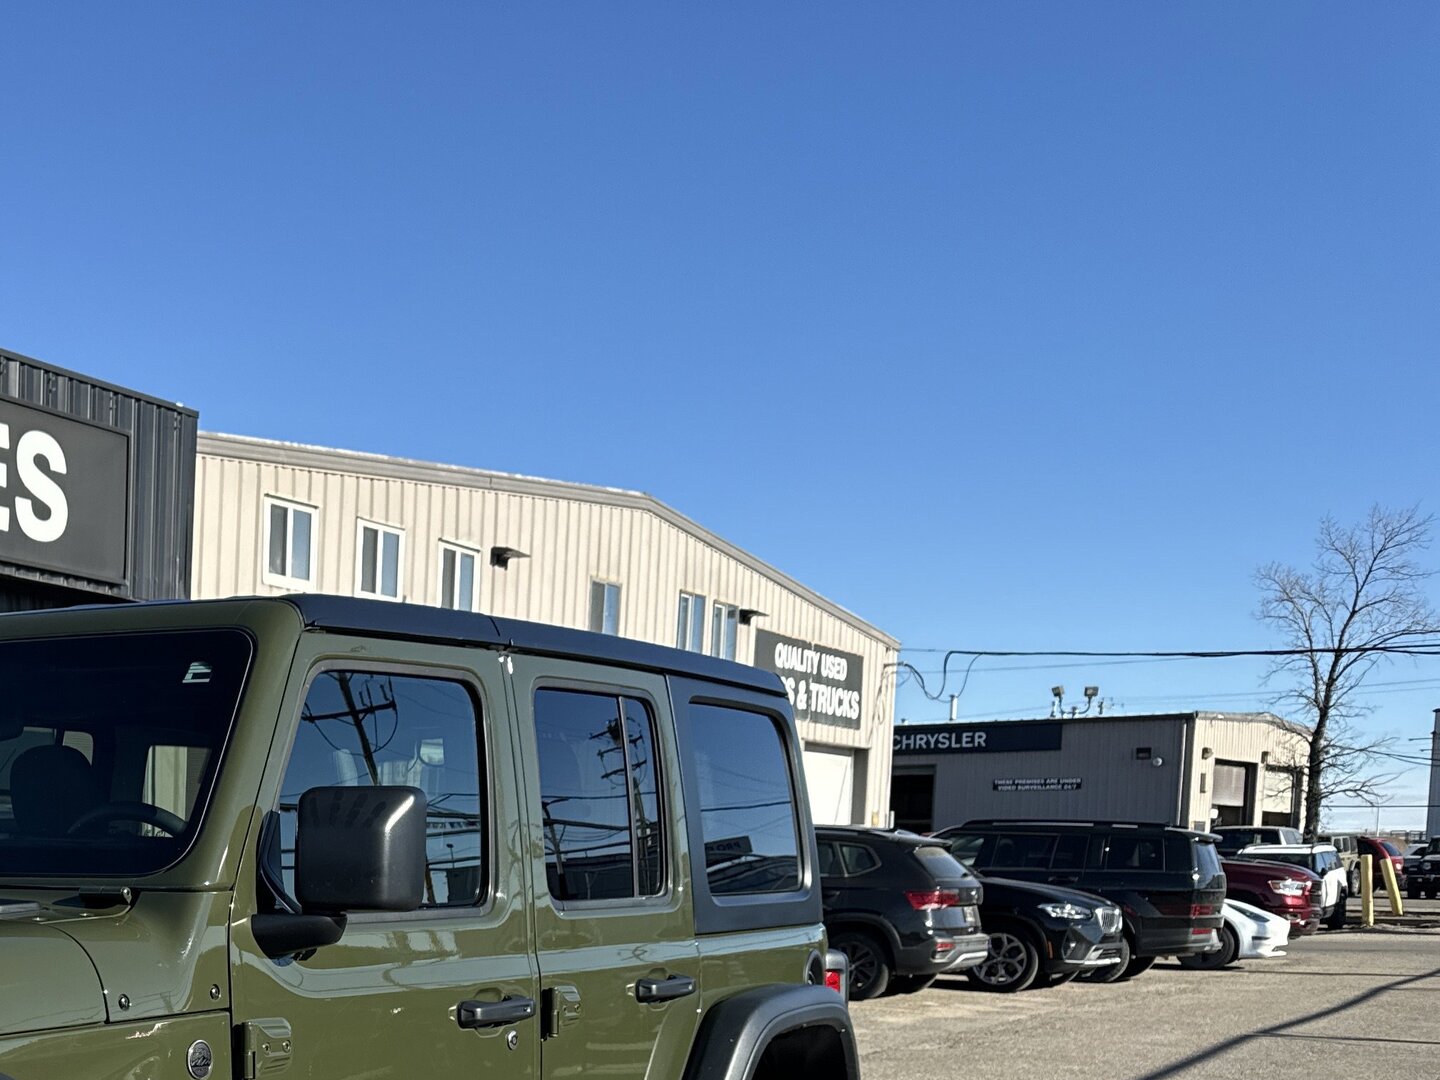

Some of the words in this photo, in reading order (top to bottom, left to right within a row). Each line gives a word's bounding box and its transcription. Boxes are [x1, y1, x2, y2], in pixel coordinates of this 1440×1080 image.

[774, 642, 820, 675] QUALITY
[821, 653, 848, 681] USED
[796, 680, 807, 710] &
[809, 682, 860, 719] TRUCKS
[893, 731, 987, 750] CHRYSLER
